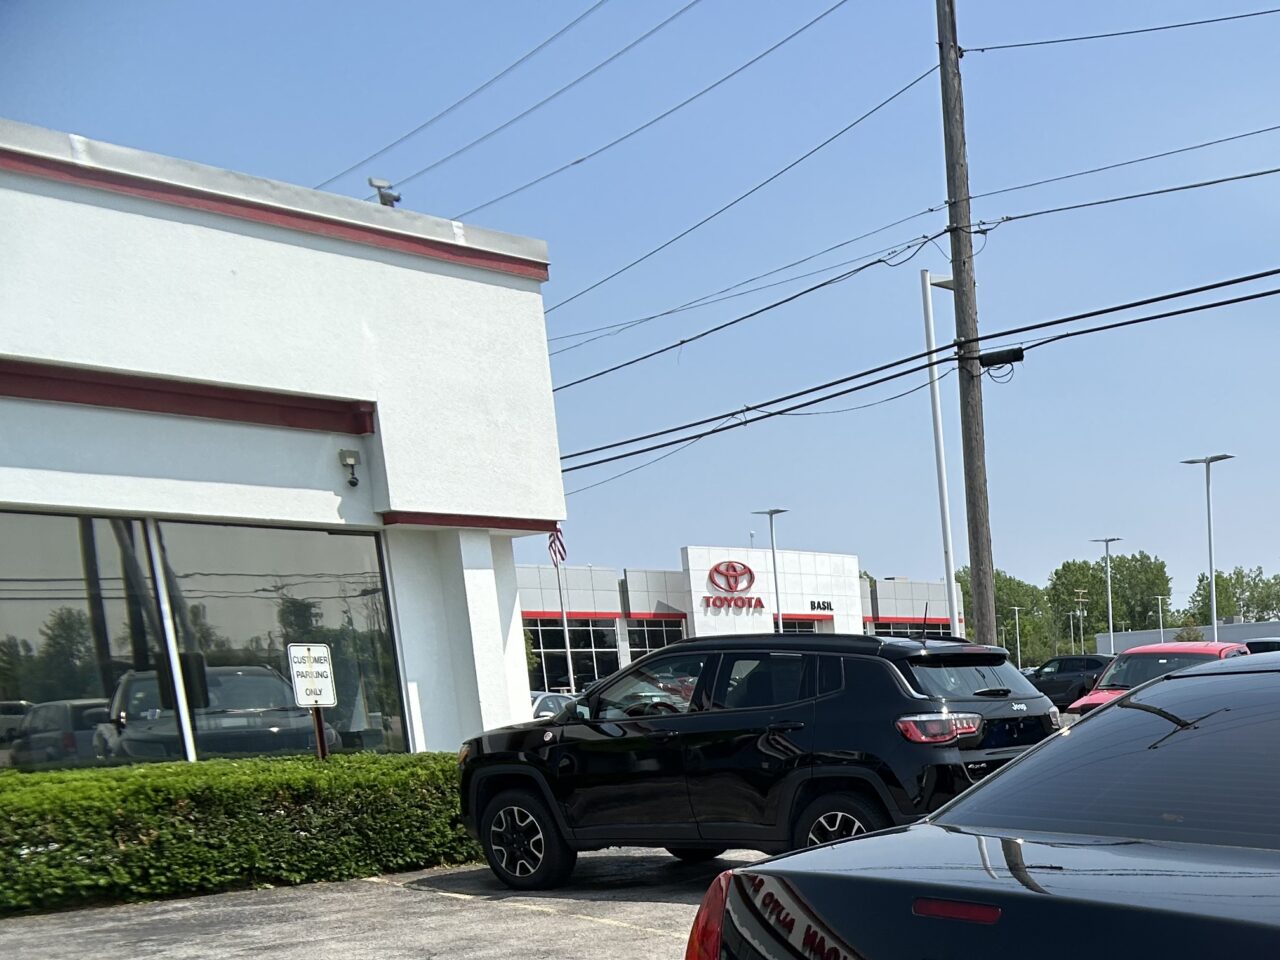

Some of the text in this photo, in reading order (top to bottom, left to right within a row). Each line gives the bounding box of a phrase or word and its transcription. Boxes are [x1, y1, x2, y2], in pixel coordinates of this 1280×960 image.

[703, 596, 765, 609] TOYOTA
[810, 601, 834, 611] BASIL
[293, 656, 328, 664] CUSTOMER
[296, 671, 329, 679] PARKING
[305, 688, 323, 696] ONLY
[1012, 702, 1027, 711] Jeep
